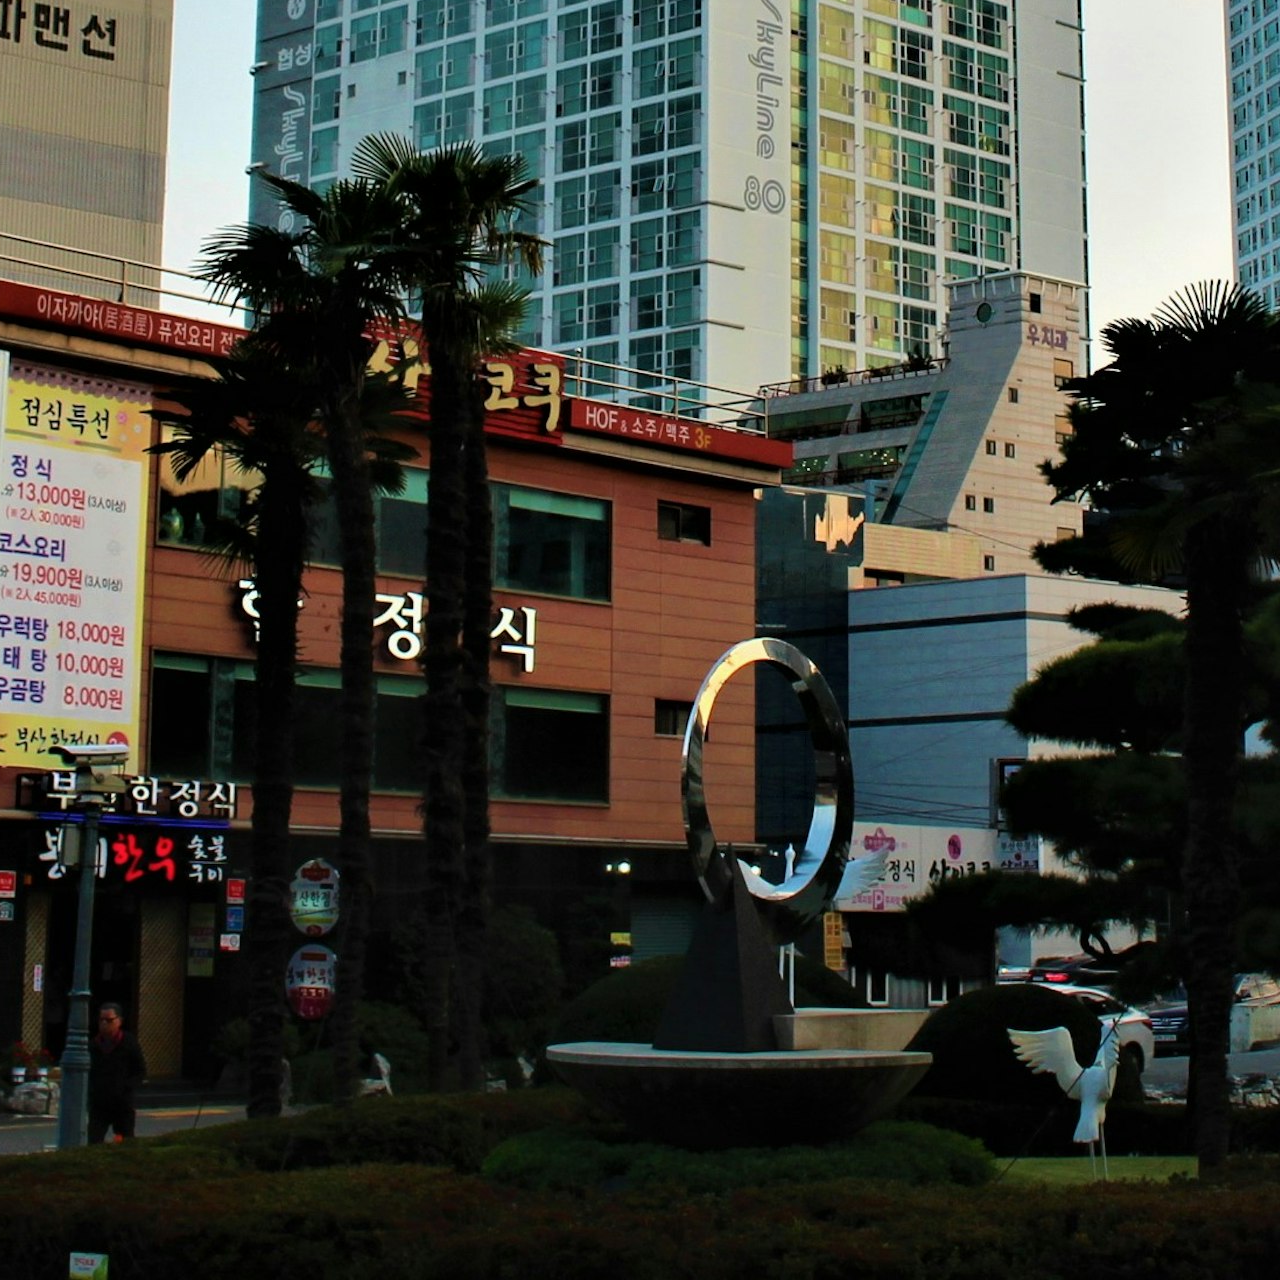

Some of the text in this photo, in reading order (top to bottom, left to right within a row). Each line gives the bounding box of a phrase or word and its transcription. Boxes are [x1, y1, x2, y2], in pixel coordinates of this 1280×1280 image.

[277, 42, 312, 72] 협성
[743, 175, 787, 215] 80
[1026, 323, 1069, 351] 우치과
[366, 338, 562, 433] 사코쿠
[20, 396, 109, 440] 점심특선
[585, 404, 713, 450] HOF & 소주/맥주 3F
[16, 482, 86, 510] 13,000원
[11, 562, 83, 591] 19,900원
[57, 620, 125, 647] 18,000원
[55, 652, 124, 679] 10,000원
[63, 685, 123, 711] 8,000원
[45, 770, 237, 819] 부한정식
[187, 834, 228, 861] 숯불
[188, 864, 224, 883] 구이
